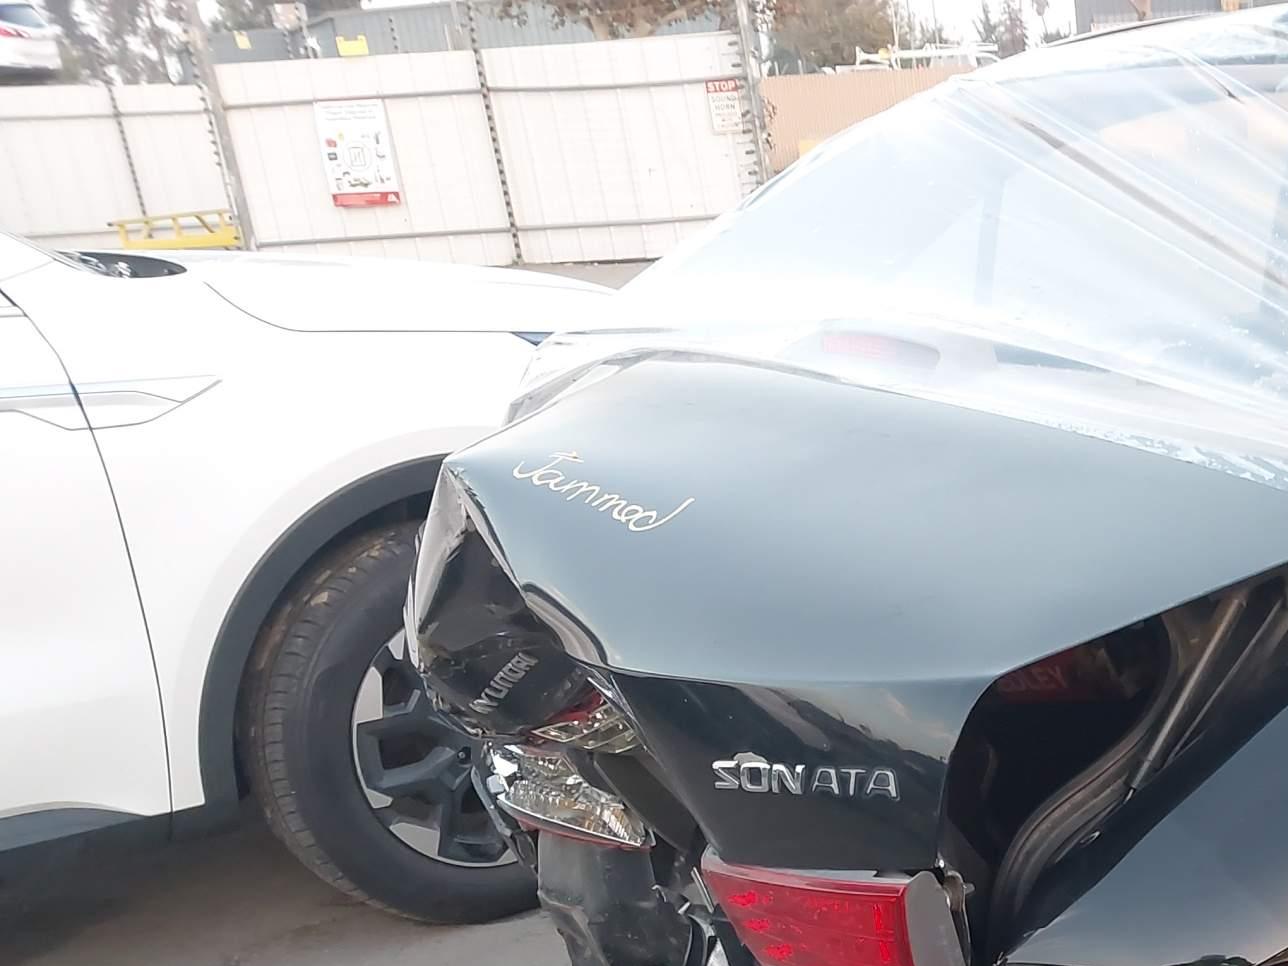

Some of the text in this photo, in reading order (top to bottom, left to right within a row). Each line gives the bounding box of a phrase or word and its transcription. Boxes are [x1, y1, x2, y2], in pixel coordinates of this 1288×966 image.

[707, 80, 736, 92] STOP
[512, 450, 696, 532] Jammed
[711, 759, 900, 801] SONATA
